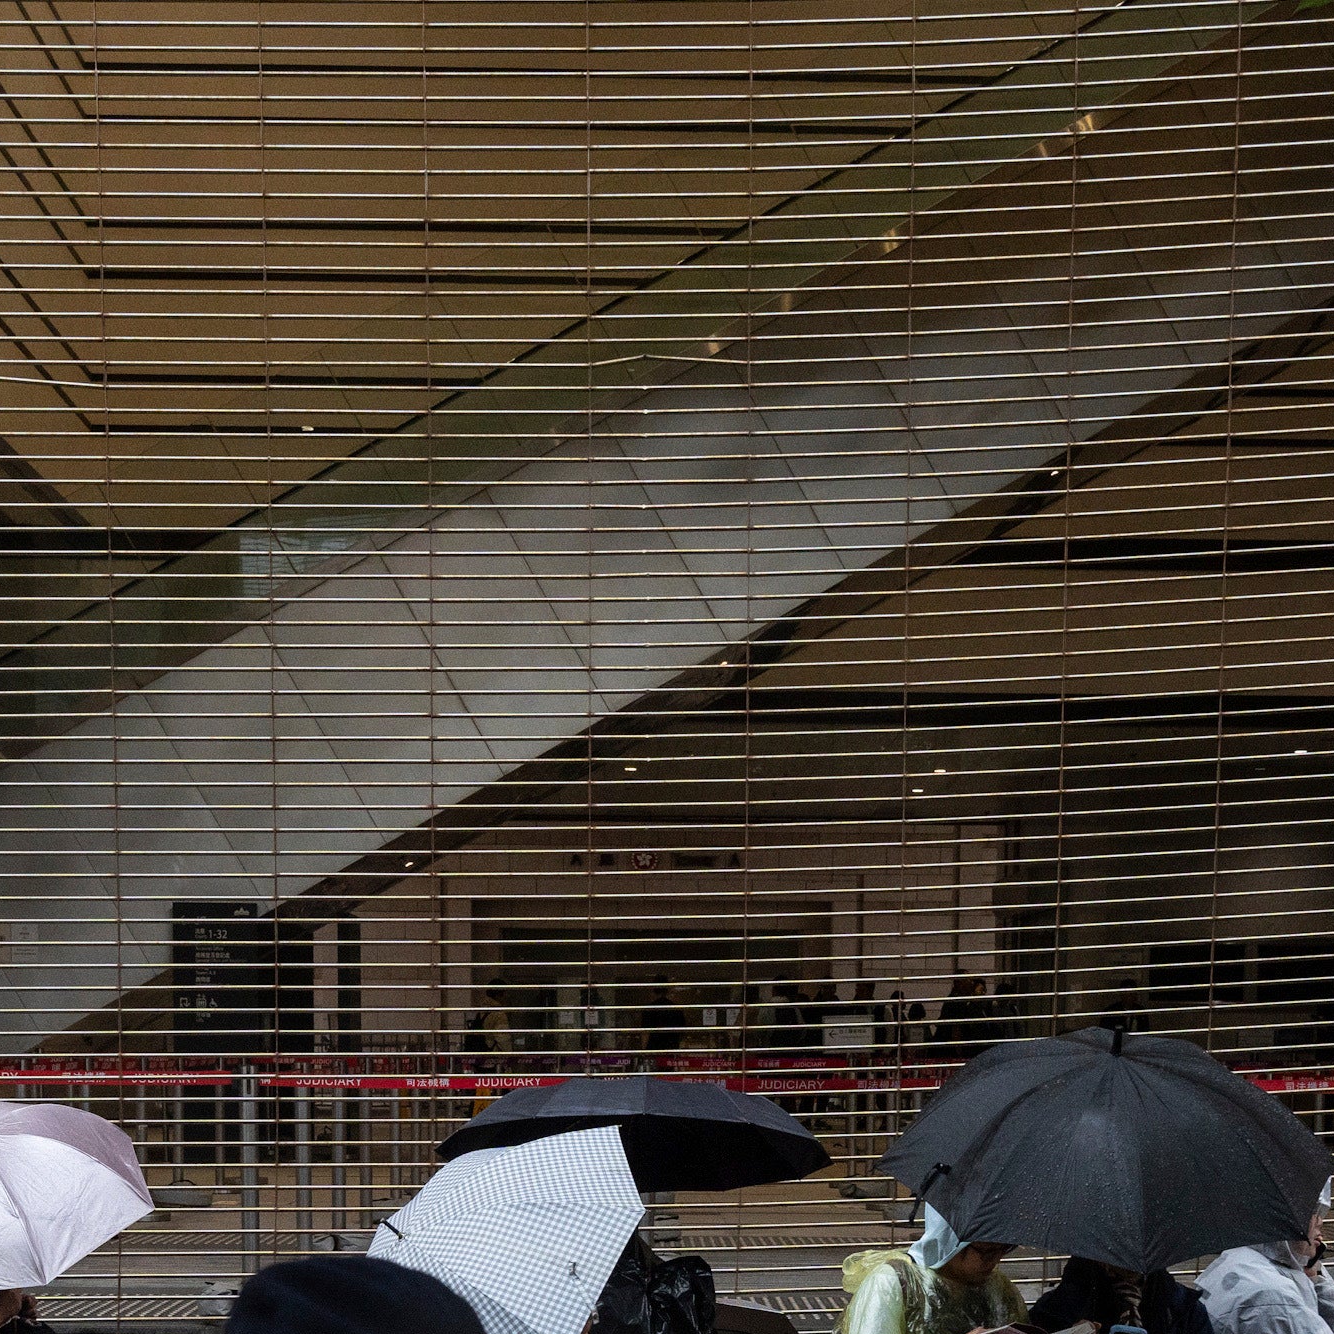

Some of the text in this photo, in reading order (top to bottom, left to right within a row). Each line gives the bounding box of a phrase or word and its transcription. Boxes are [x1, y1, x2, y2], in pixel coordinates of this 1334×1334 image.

[208, 929, 229, 939] 1-32
[474, 1078, 541, 1087] JUDICIARY
[757, 1079, 825, 1090] JUDICIARY
